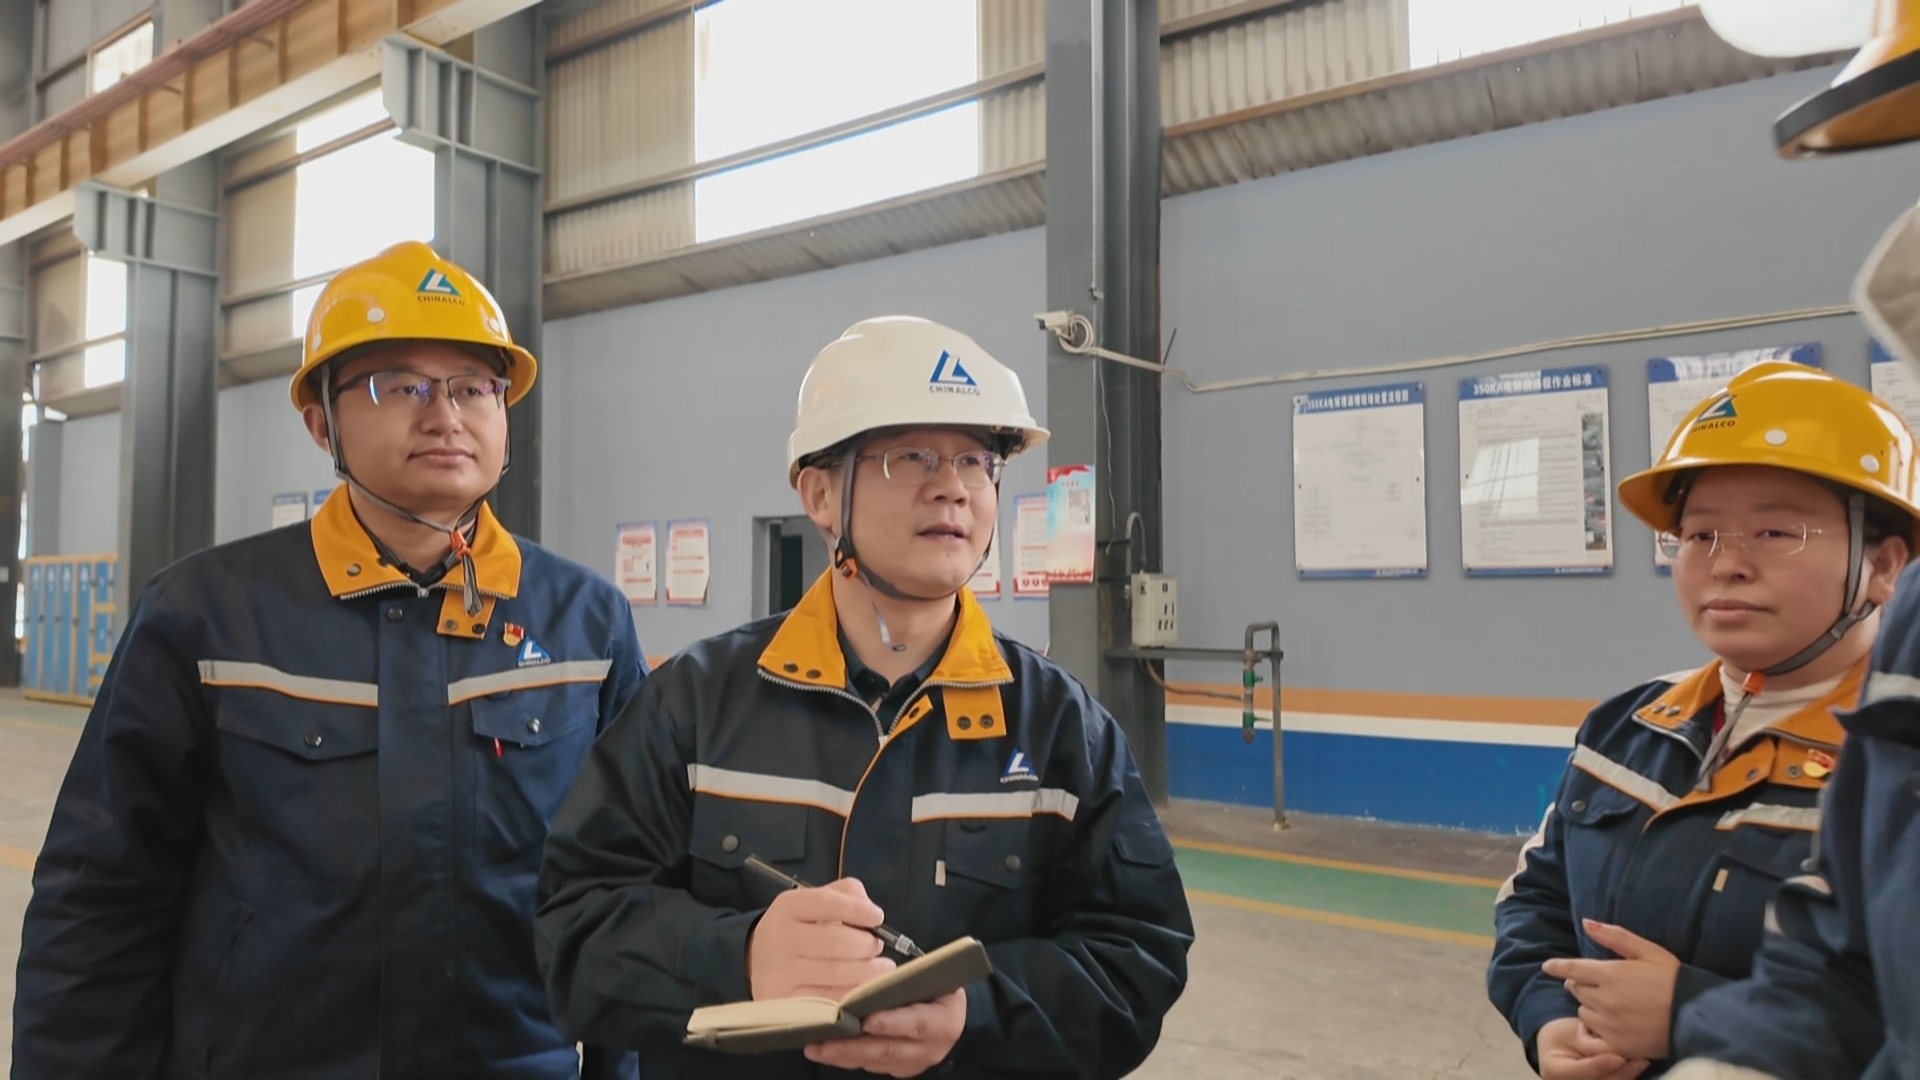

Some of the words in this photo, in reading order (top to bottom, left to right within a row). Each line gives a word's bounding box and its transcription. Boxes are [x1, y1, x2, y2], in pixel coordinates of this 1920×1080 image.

[416, 295, 466, 307] CHINALCO
[928, 385, 980, 397] CHINALCO
[1689, 420, 1736, 434] HINALCO
